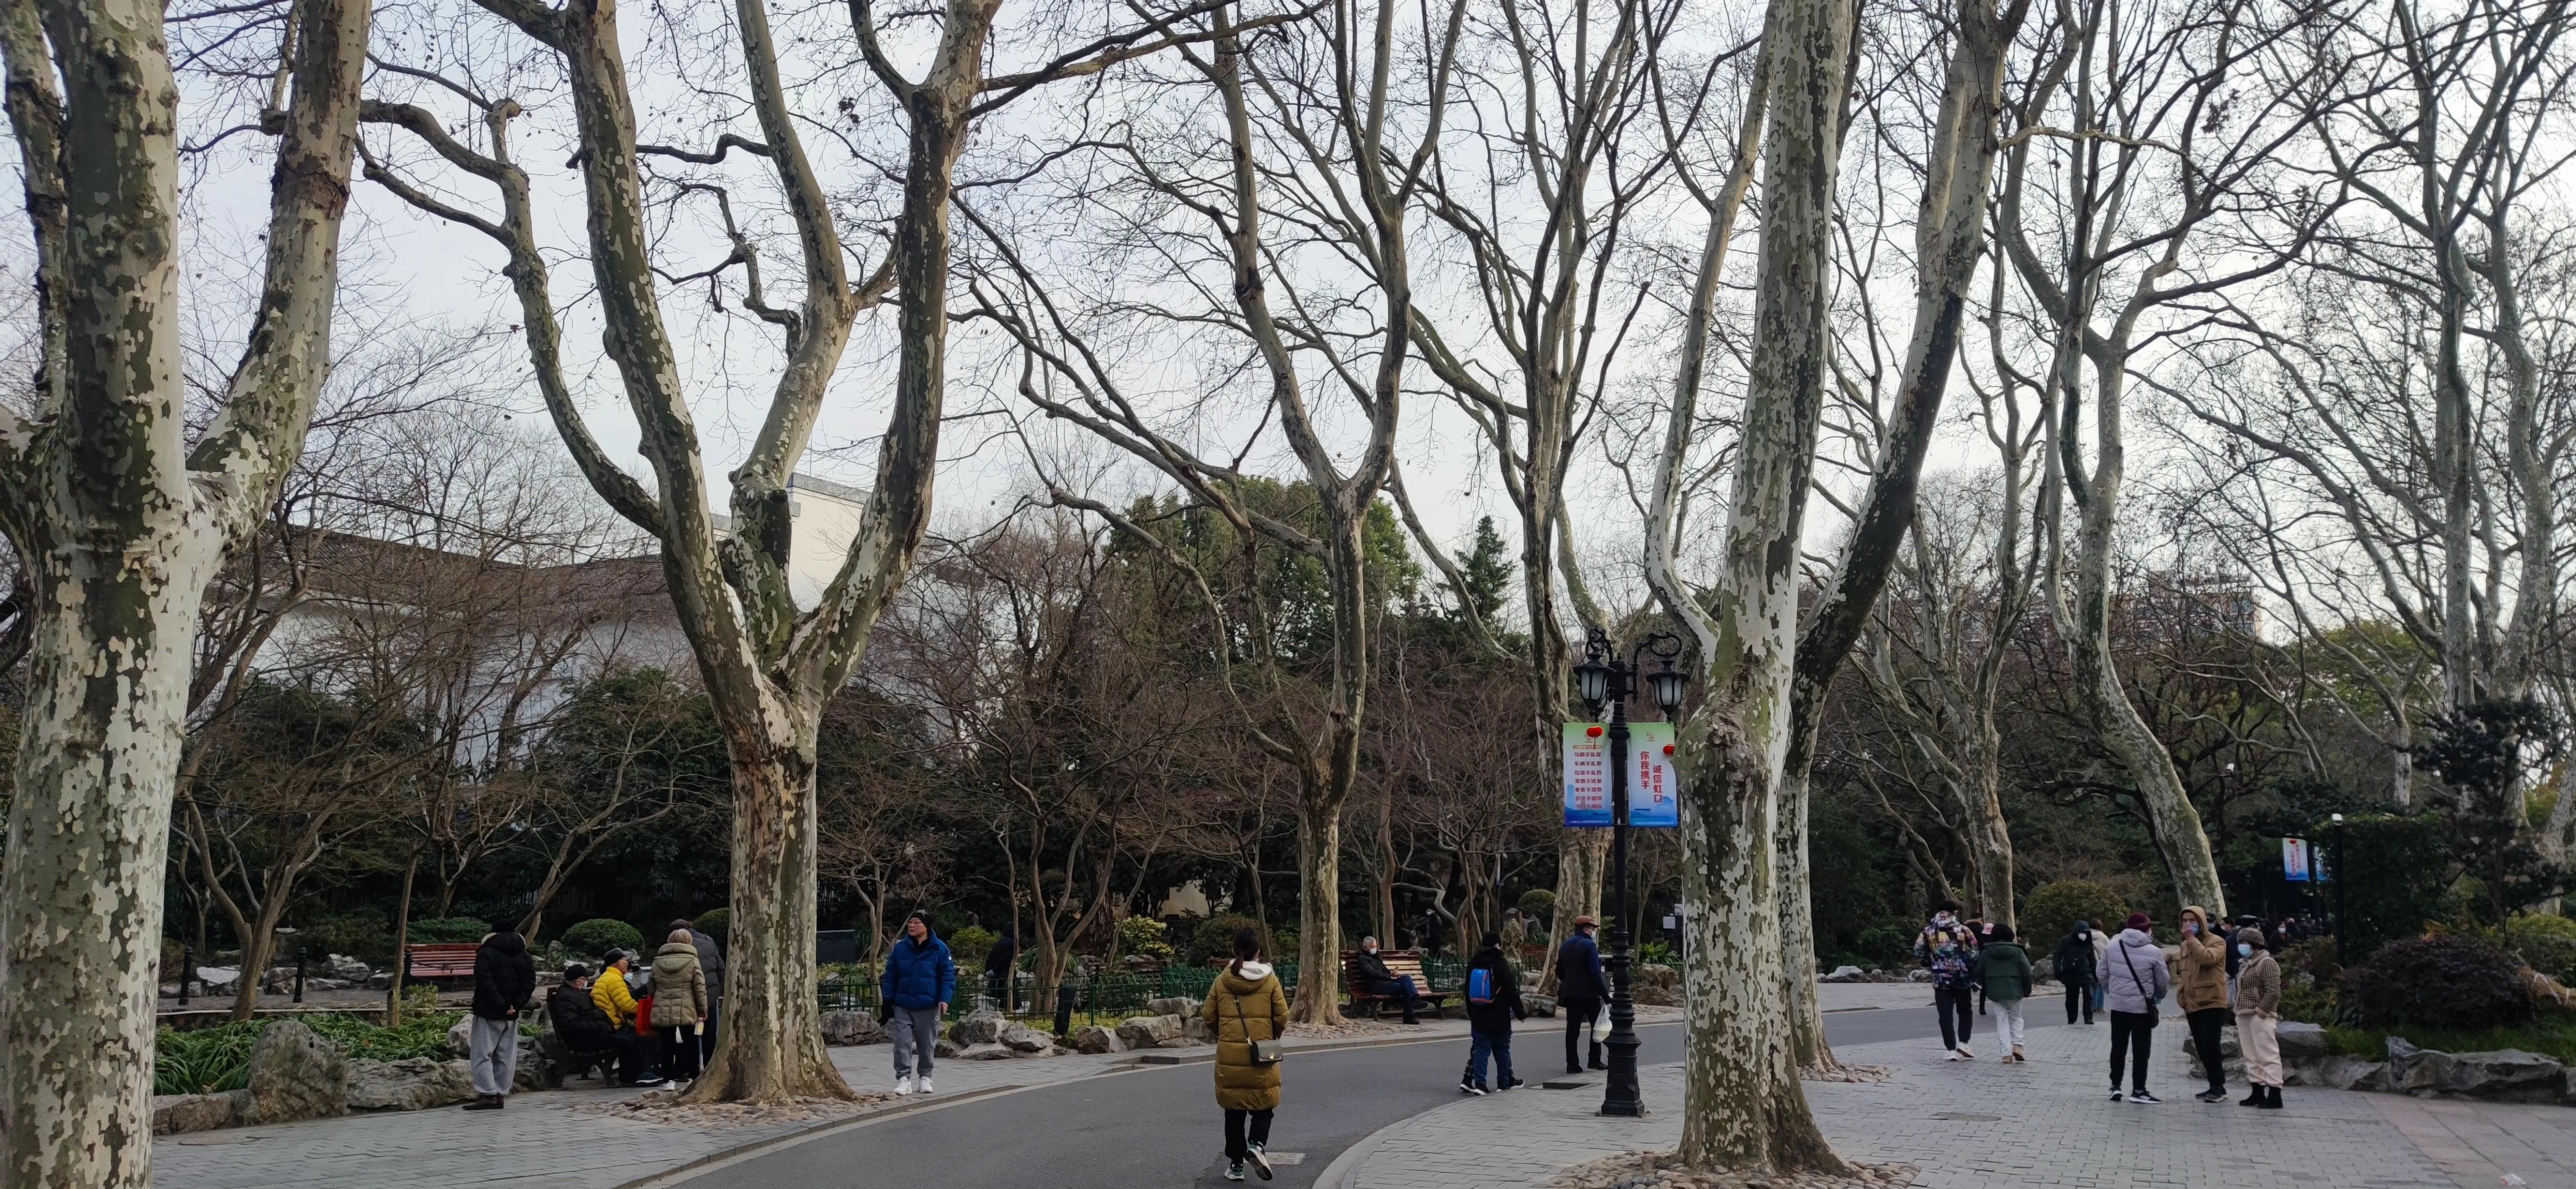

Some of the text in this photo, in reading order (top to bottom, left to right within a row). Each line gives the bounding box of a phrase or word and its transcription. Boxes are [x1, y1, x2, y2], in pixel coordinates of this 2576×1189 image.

[1640, 751, 1650, 789] 你我携手
[1653, 765, 1663, 803] 诚信虹口
